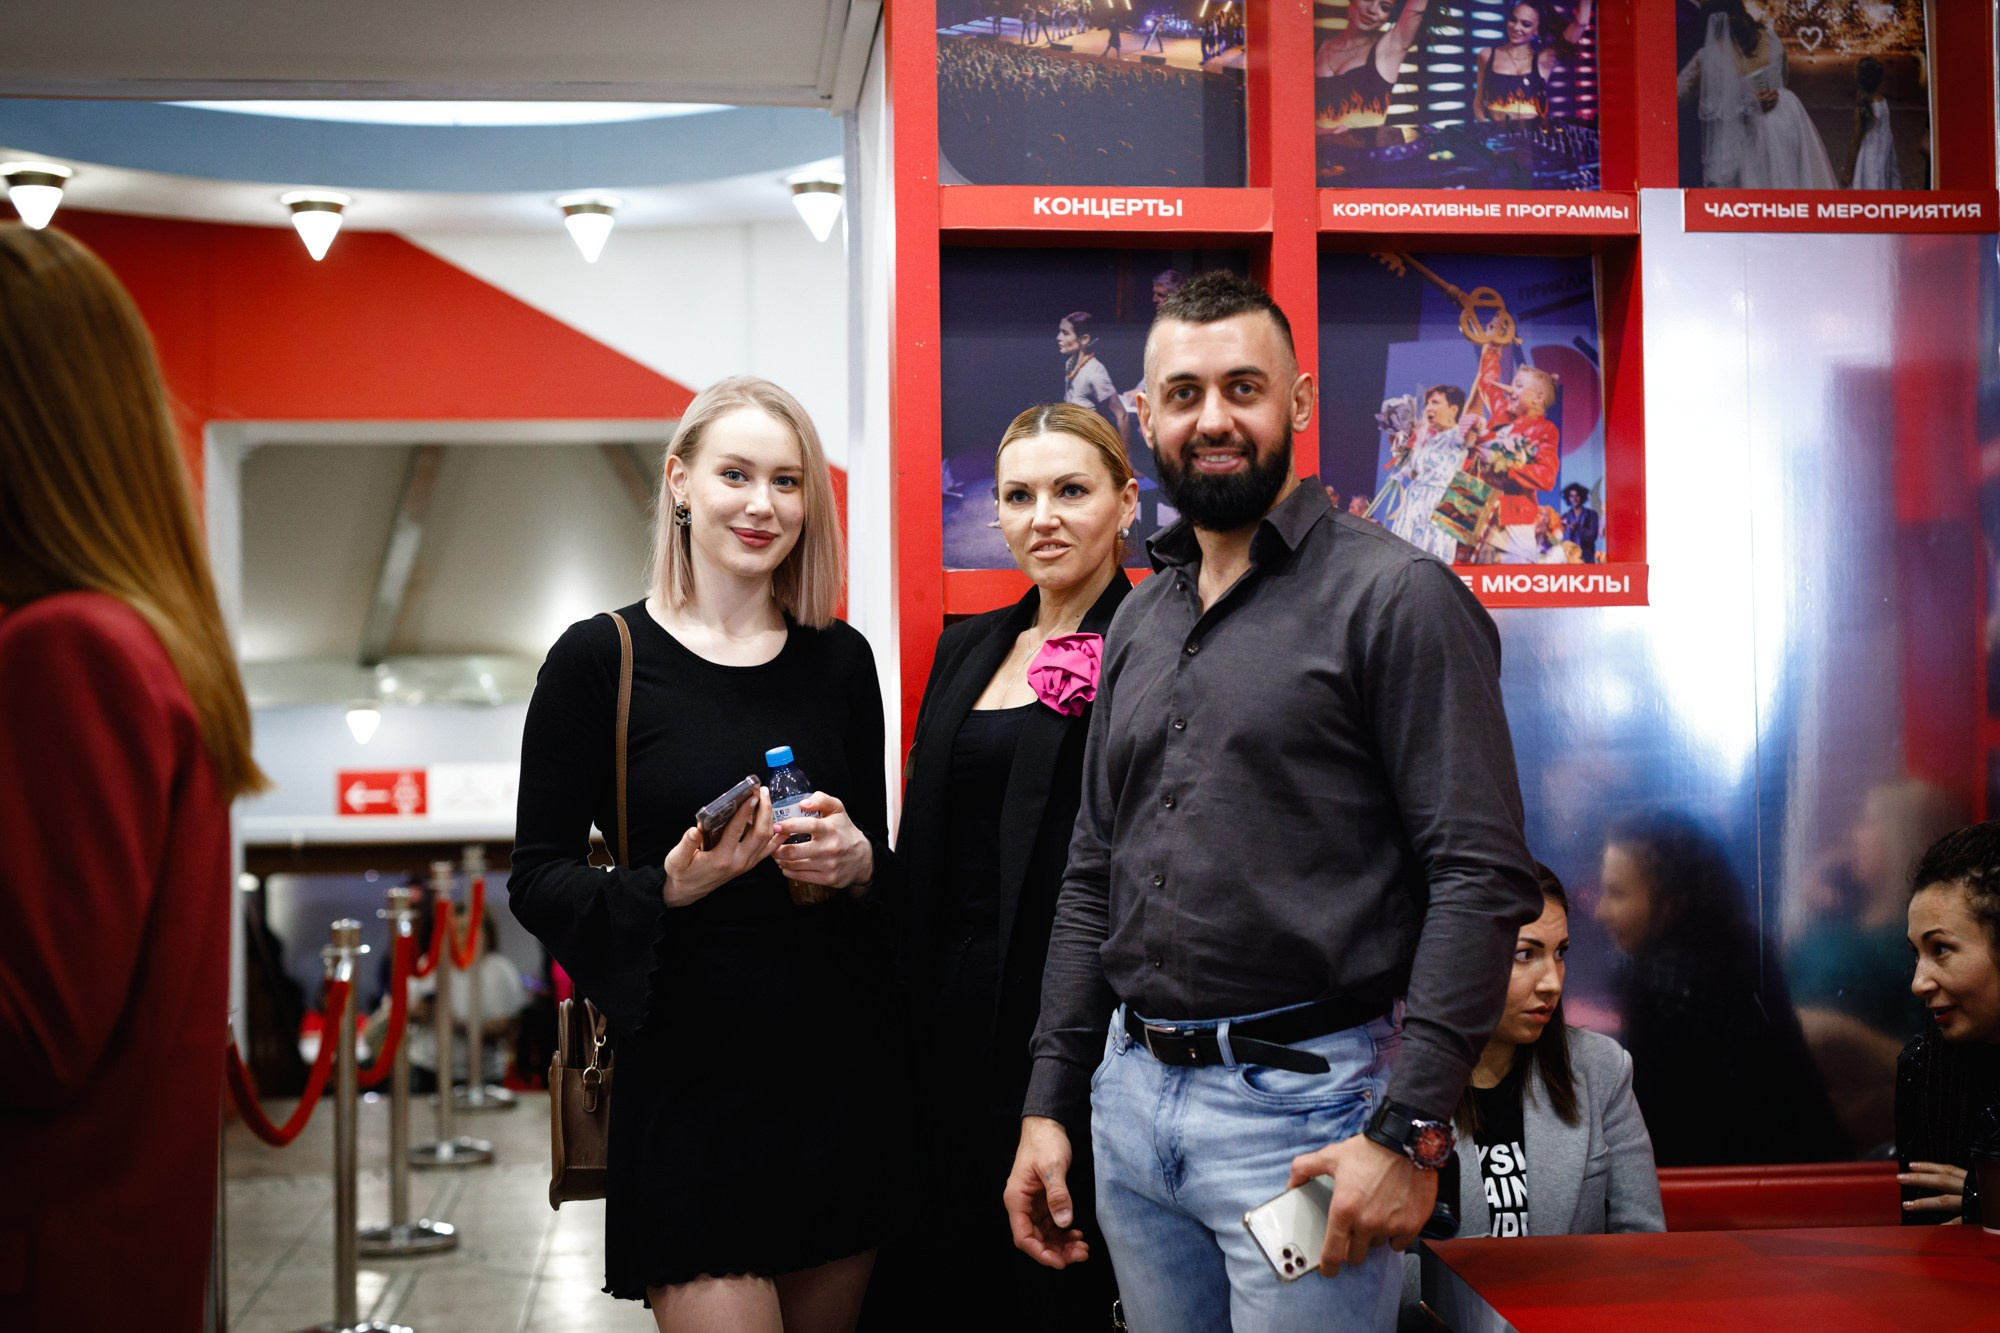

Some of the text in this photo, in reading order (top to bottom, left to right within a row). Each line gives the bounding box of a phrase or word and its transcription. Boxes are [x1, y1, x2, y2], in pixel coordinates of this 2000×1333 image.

[1033, 196, 1183, 219] КОНЦЕРТЫ
[1332, 202, 1629, 219] КОРПОРАТИВНЫЕ ПРОГРАММЫ
[1704, 202, 1982, 218] ЧАСТНЫЕ МЕРОПРИЯТИЯ
[1481, 574, 1631, 593] МЮЗИКЛЫ
